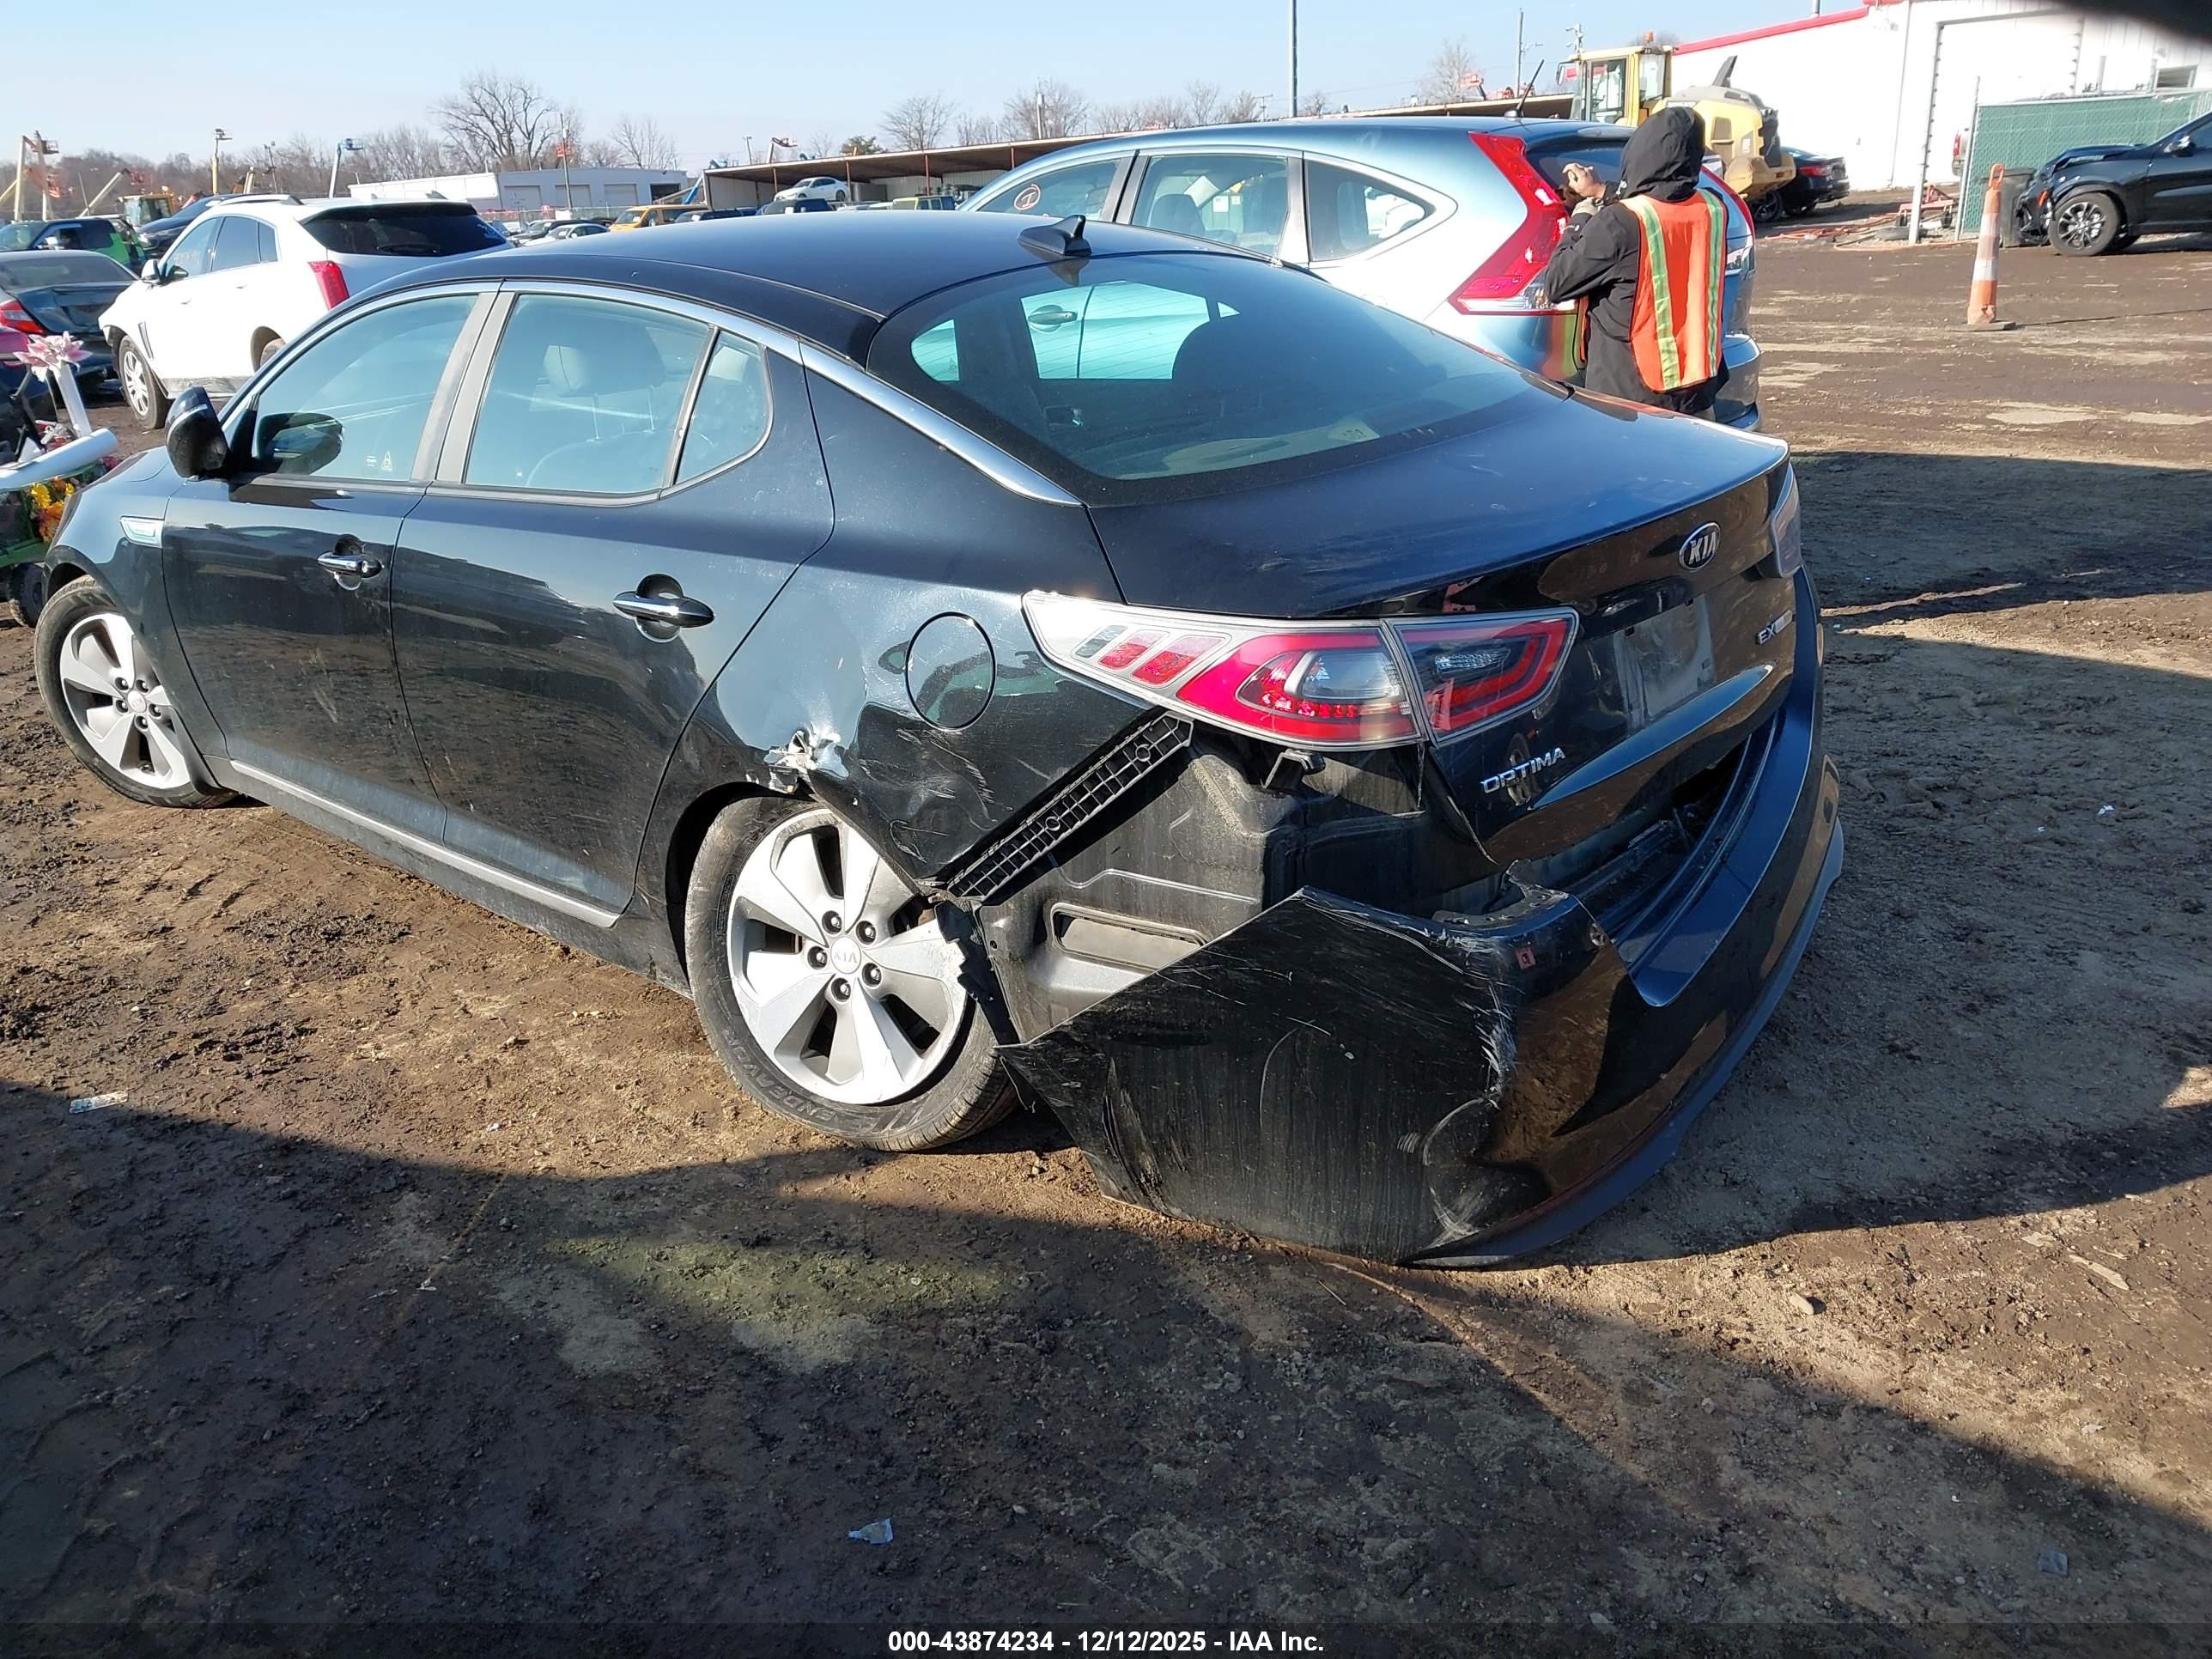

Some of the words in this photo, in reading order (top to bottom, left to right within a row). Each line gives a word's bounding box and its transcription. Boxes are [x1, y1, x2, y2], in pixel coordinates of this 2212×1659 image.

[1688, 532, 1717, 564] KIA
[1480, 747, 1566, 793] OPTIMA
[722, 1030, 837, 1121] ENDEAVOR
